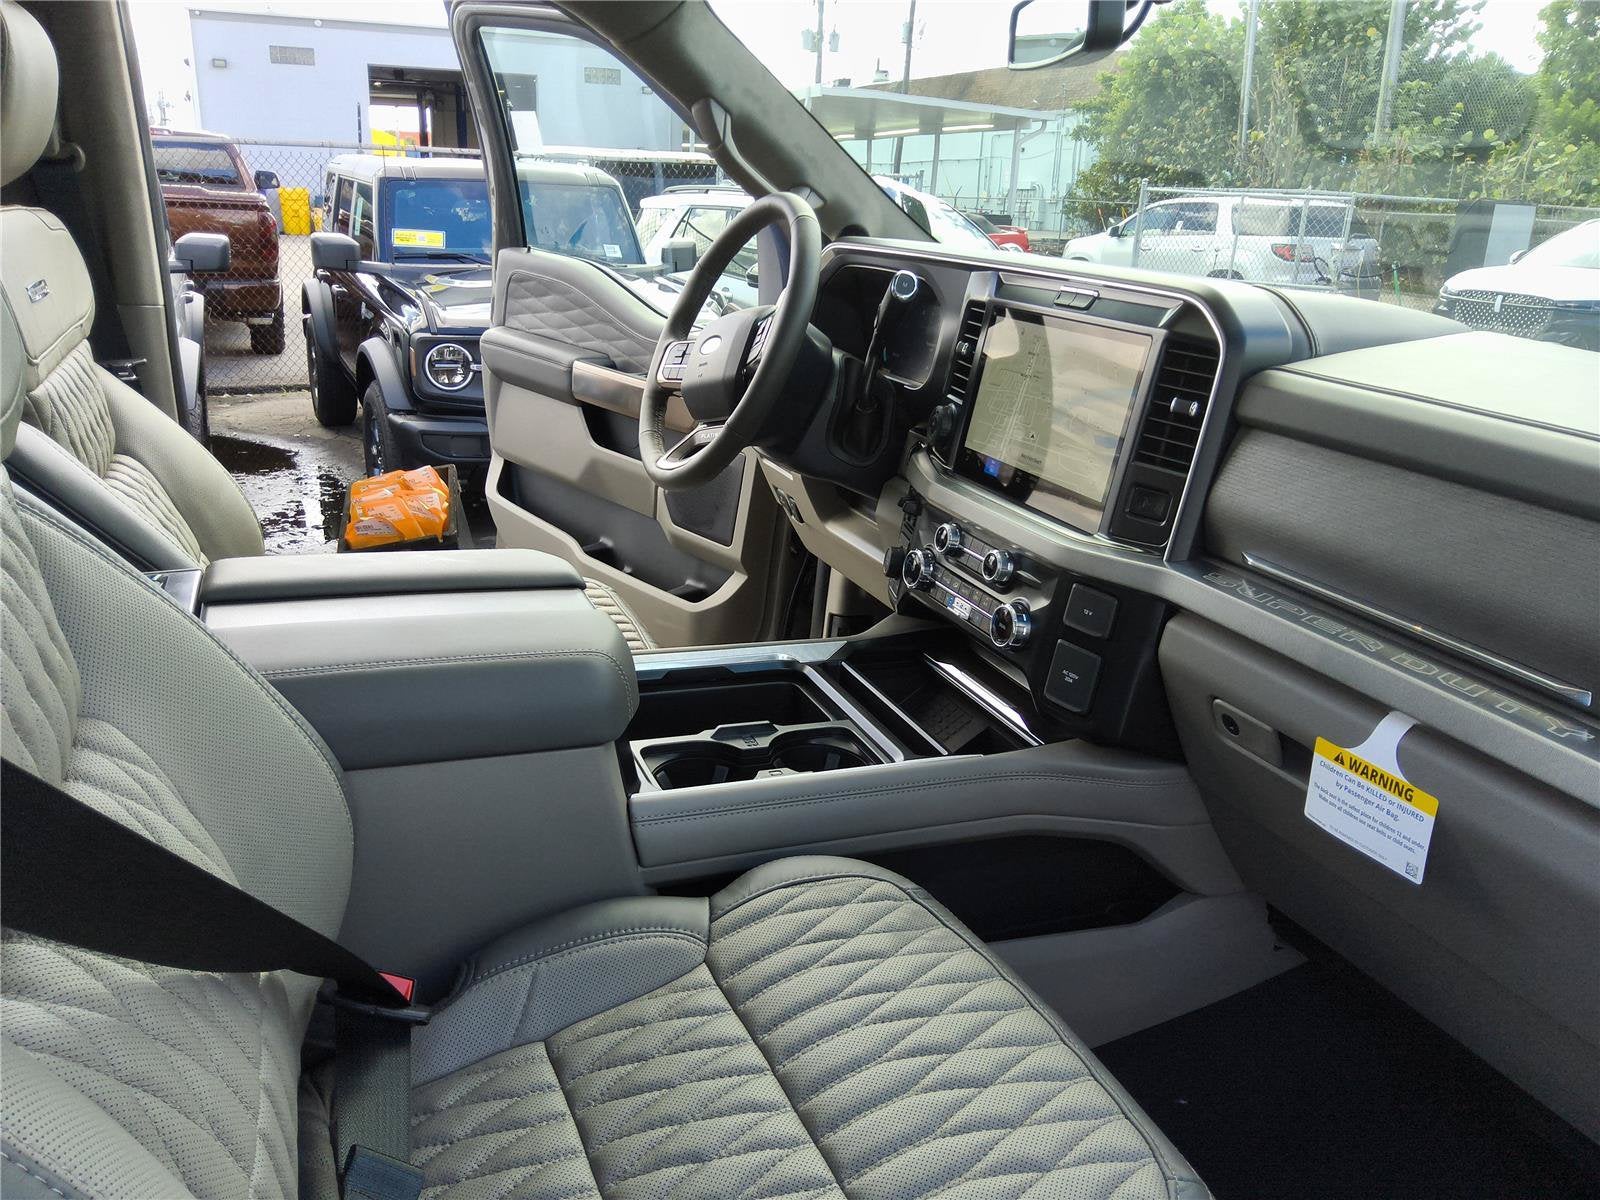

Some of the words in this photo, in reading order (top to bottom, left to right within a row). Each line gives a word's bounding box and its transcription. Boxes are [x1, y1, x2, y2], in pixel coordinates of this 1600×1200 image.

[1203, 572, 1384, 652] SUPER
[1391, 652, 1595, 738] DUTY
[1320, 760, 1343, 778] Children
[1344, 774, 1355, 784] Can
[1357, 781, 1364, 790] Be
[1366, 786, 1387, 802] KILLED
[1397, 803, 1424, 823] INJURED
[1336, 780, 1343, 790] by
[1344, 785, 1374, 808] Passenger
[1376, 803, 1385, 813] Air
[1349, 757, 1414, 802] WARNING
[1379, 820, 1395, 833] children
